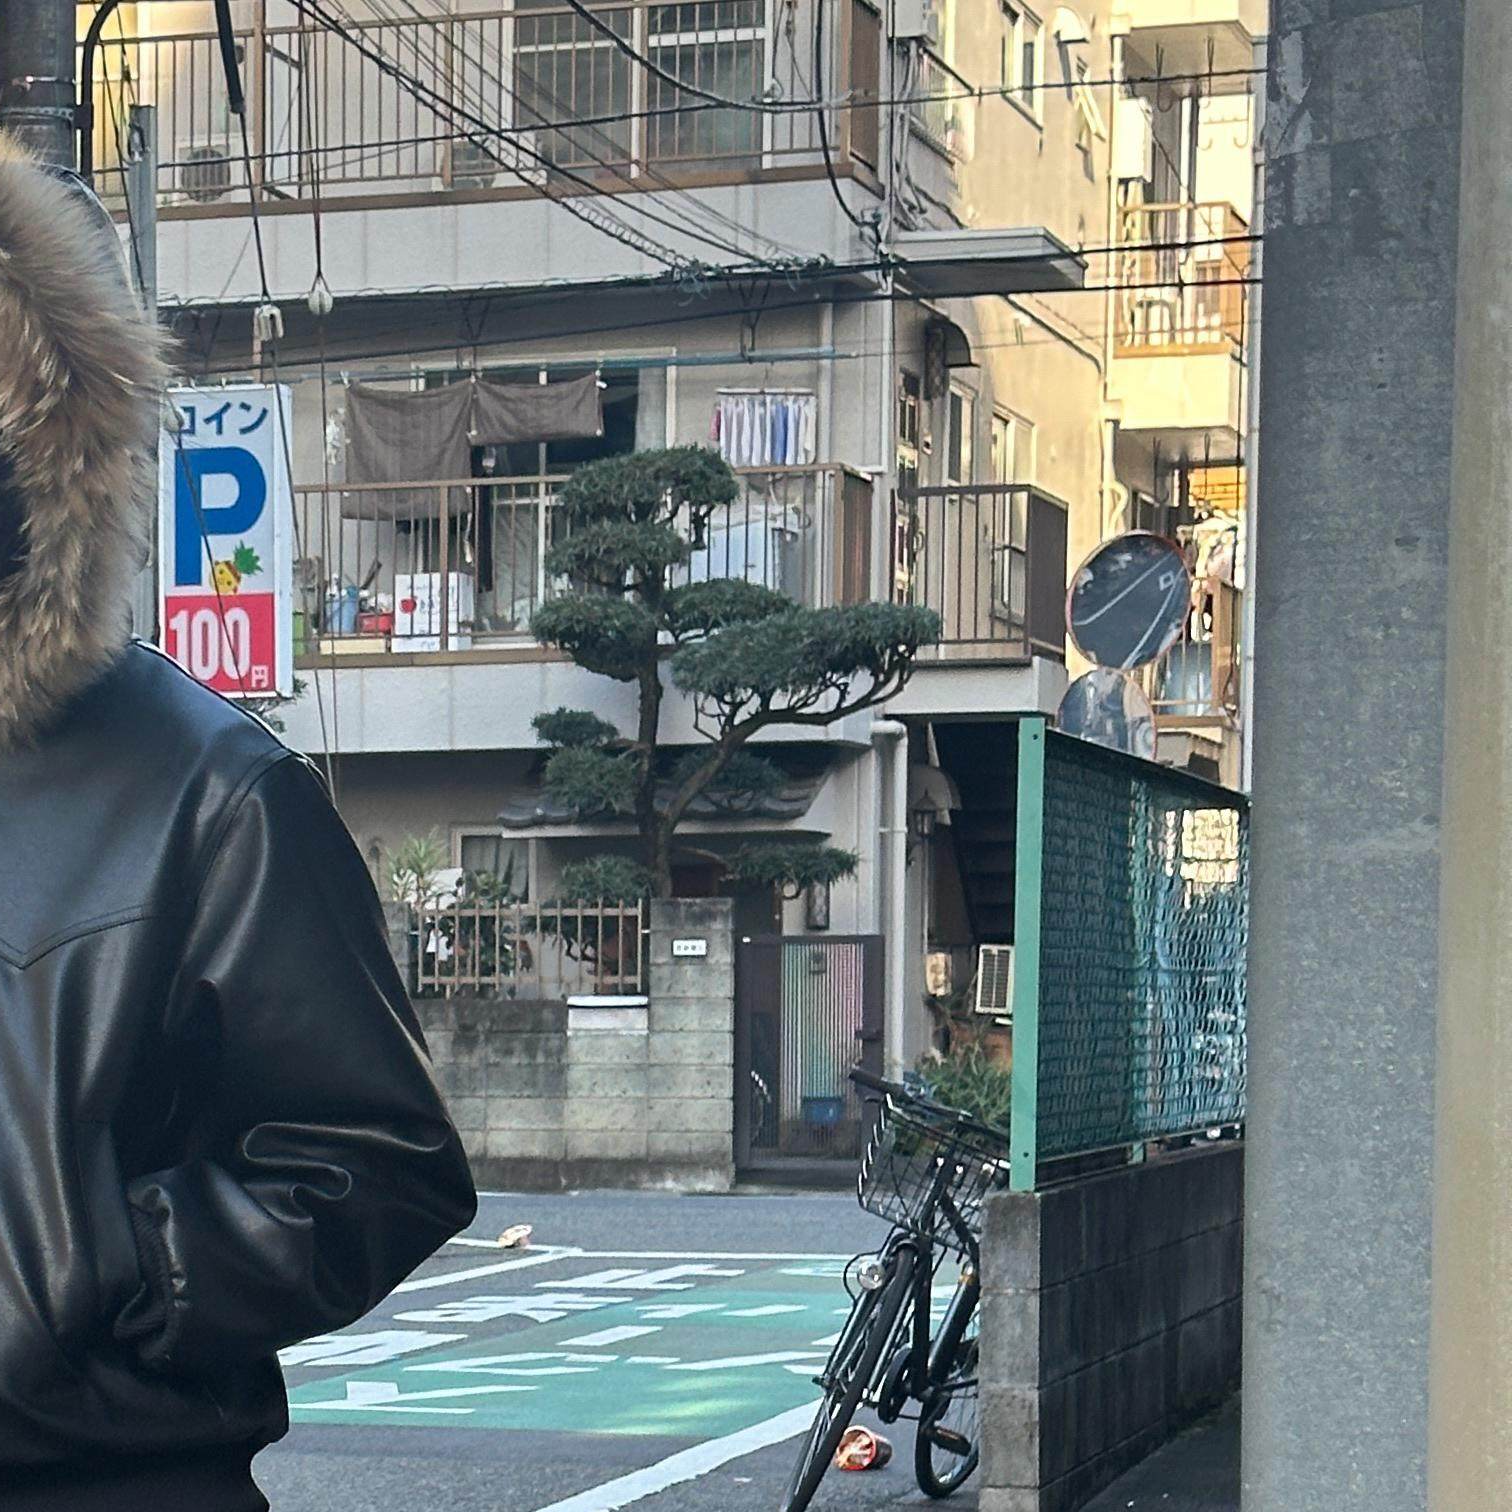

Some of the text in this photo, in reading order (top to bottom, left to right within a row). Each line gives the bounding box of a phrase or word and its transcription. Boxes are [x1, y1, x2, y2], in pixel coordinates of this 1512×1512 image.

[179, 401, 268, 435] コイン
[174, 446, 267, 586] P
